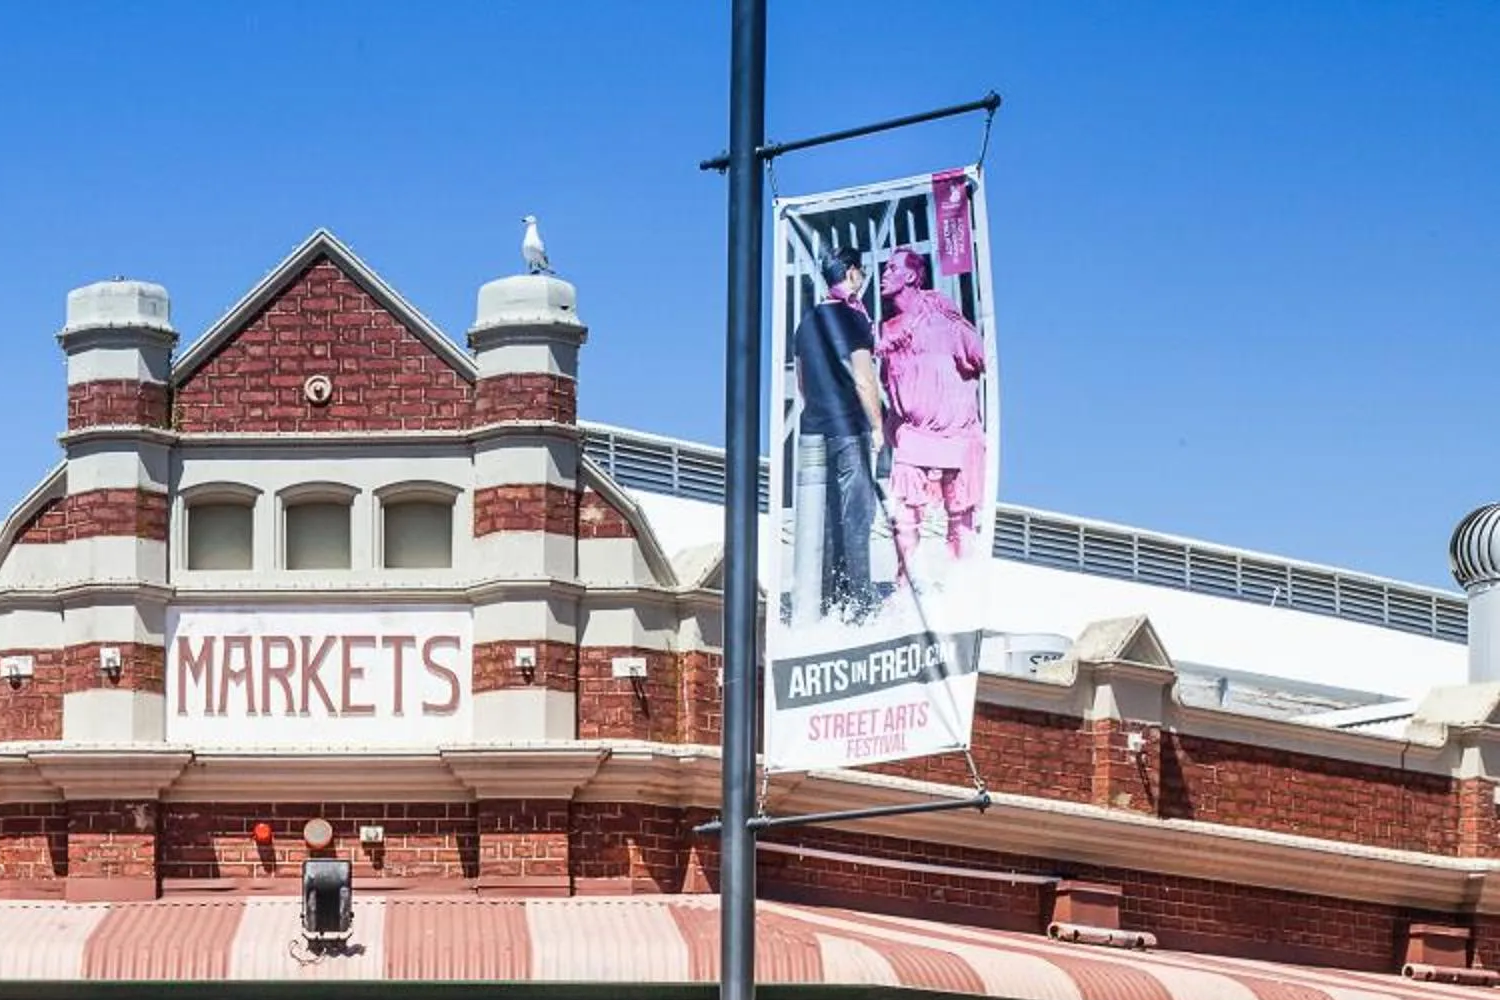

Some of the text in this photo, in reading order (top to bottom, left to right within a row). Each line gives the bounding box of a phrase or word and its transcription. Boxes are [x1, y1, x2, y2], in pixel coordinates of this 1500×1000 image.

[176, 635, 461, 717] MARKETS
[788, 660, 849, 699] ARTS
[808, 702, 930, 741] STREET ARTS
[846, 736, 907, 759] FESTIVAL
